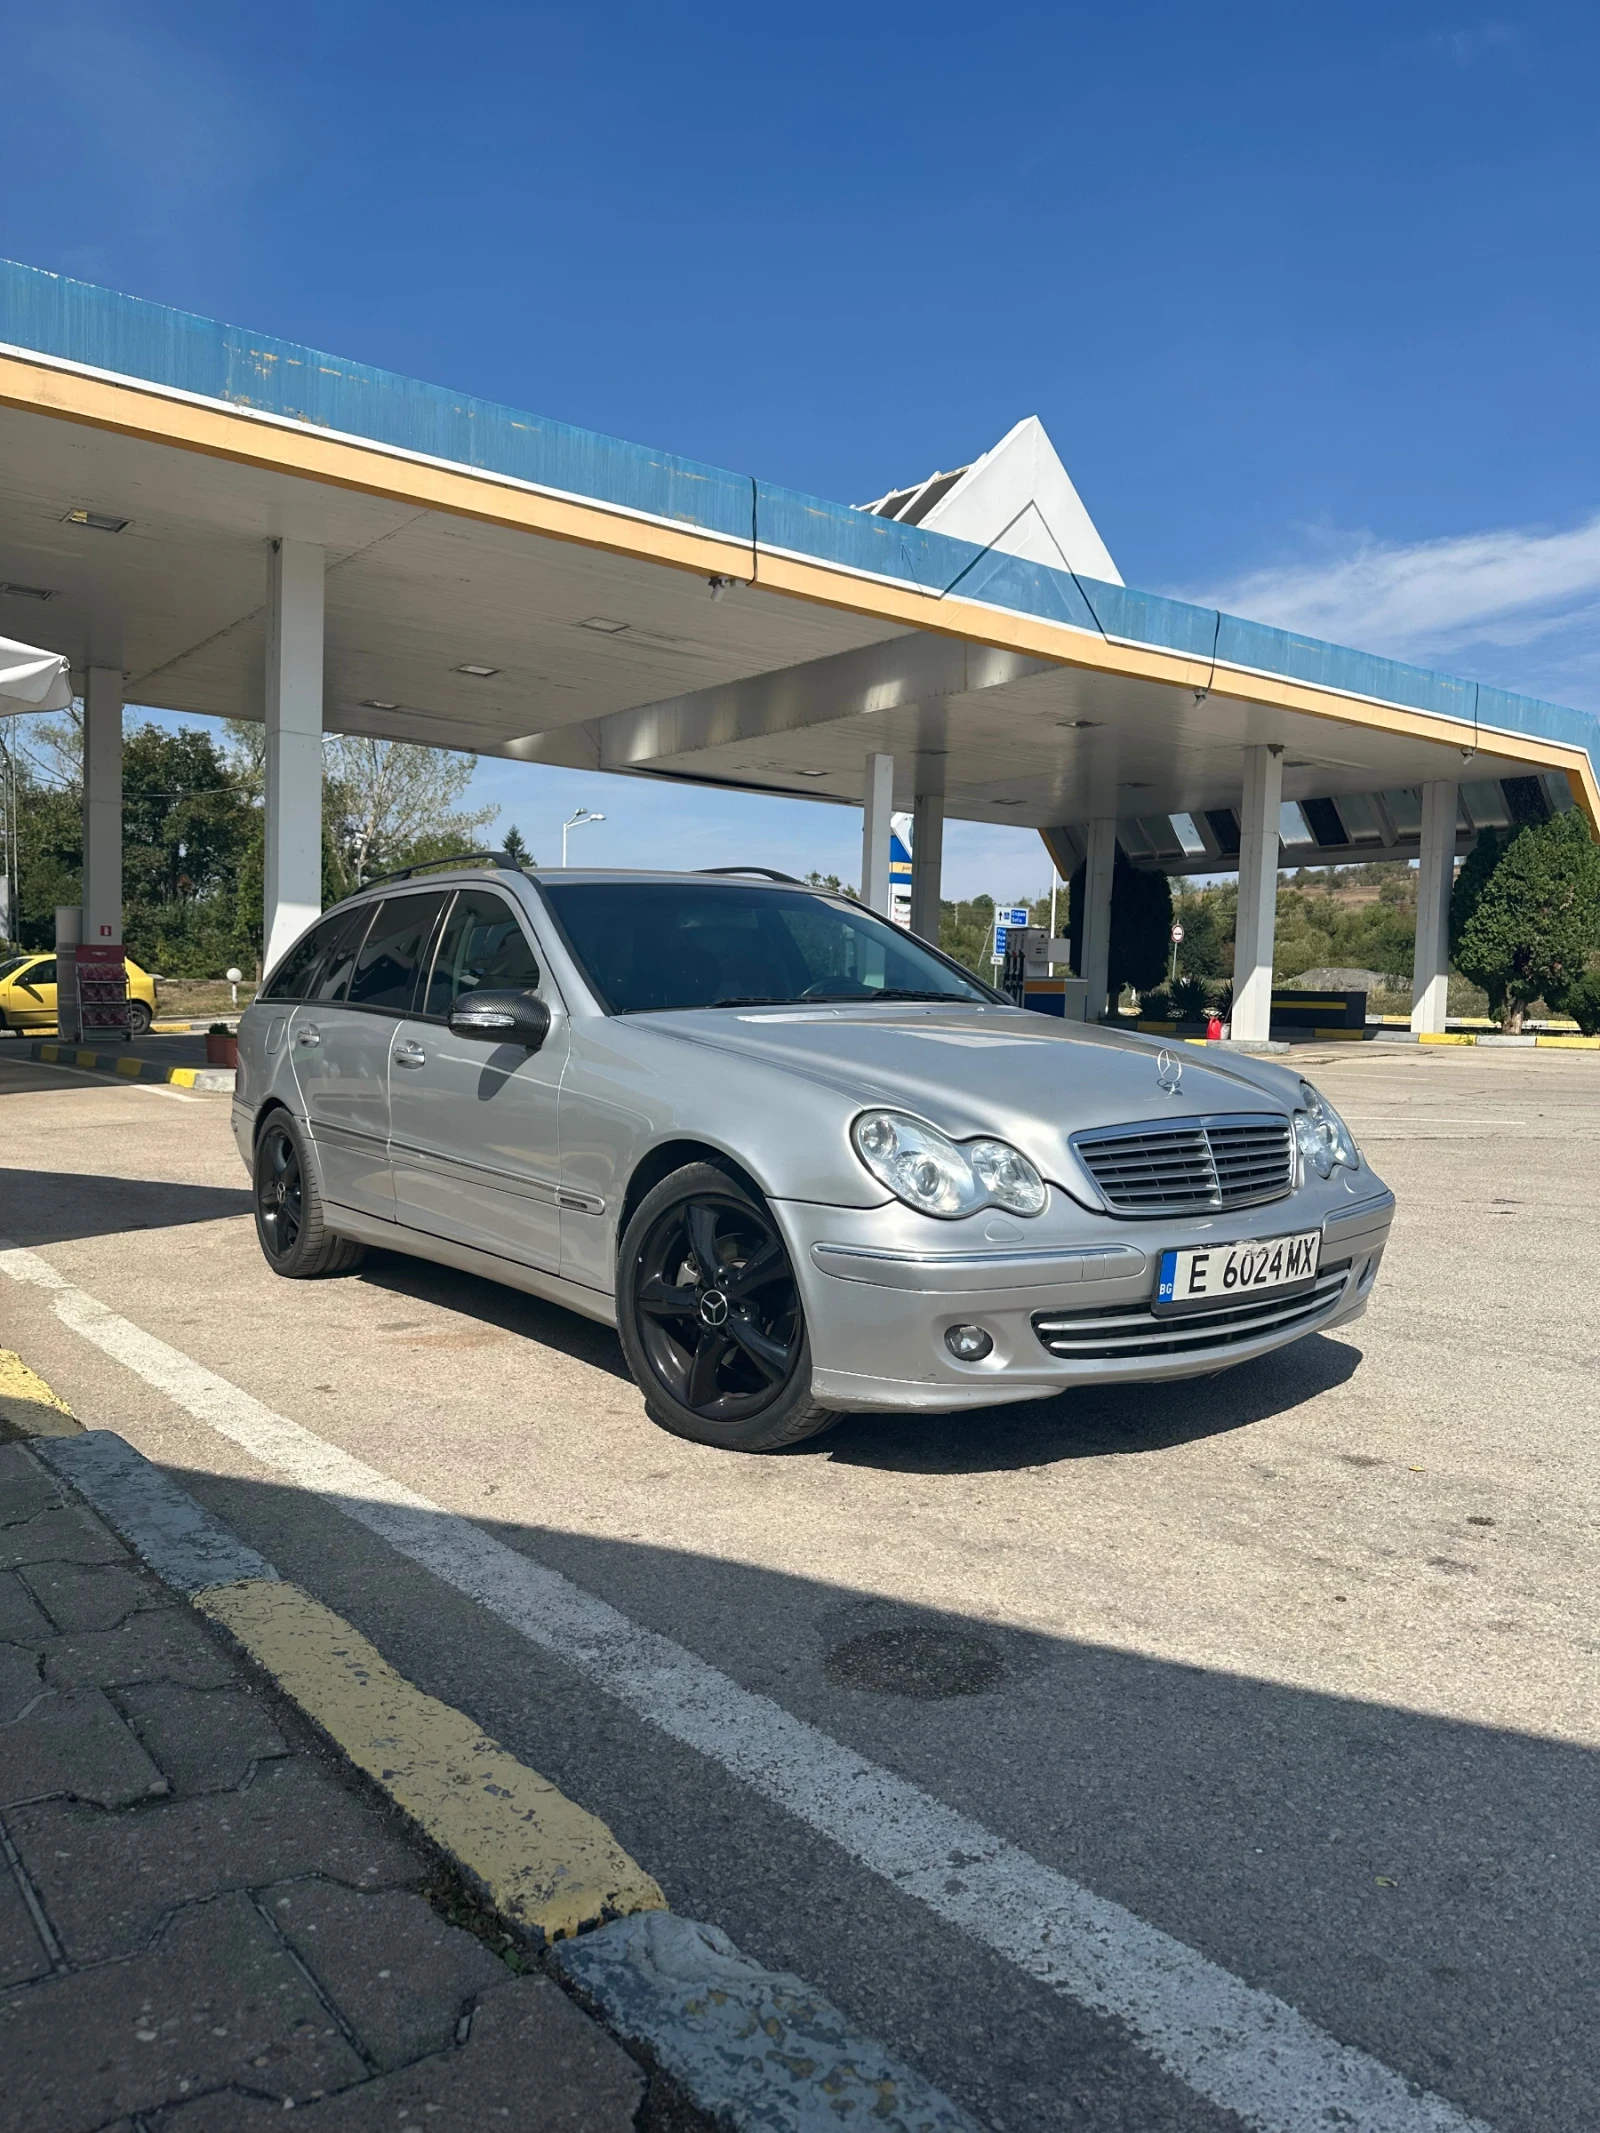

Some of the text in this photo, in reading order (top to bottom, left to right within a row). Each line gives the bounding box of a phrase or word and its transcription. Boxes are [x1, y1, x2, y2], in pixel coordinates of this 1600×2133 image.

[1188, 1237, 1316, 1293] E 6024 MX
[1159, 1283, 1172, 1295] BG
